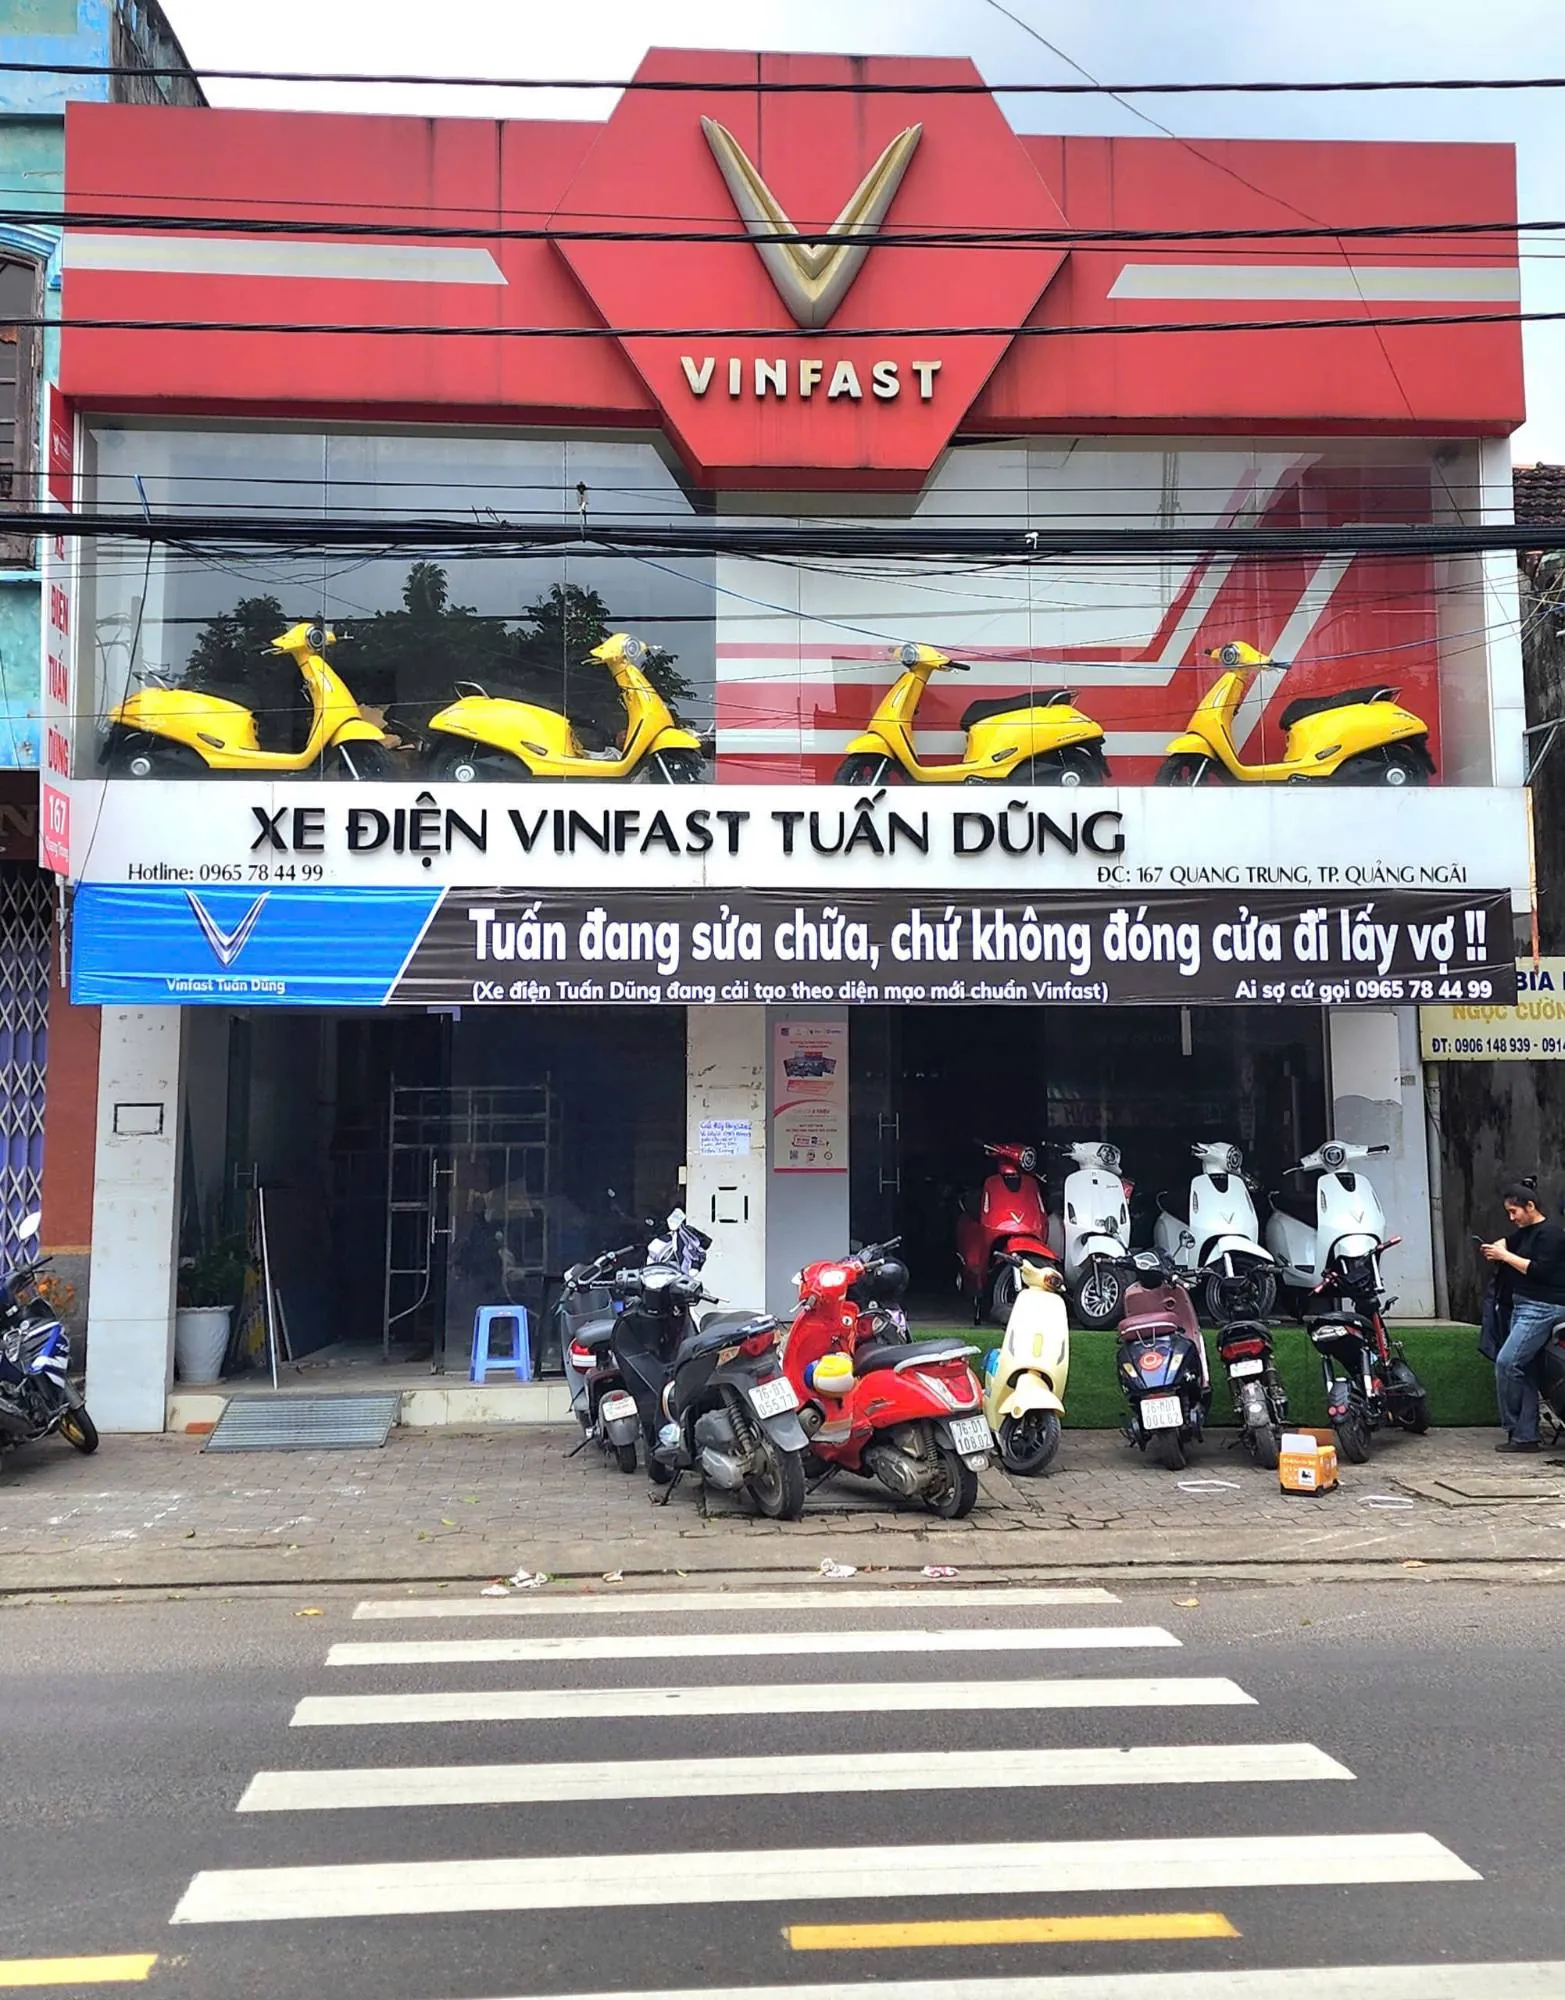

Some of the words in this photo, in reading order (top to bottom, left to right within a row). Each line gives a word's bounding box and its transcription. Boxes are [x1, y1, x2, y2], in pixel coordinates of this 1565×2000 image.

[680, 356, 943, 399] VINFAST
[48, 795, 66, 835] 167
[251, 807, 326, 852] XE
[346, 791, 487, 868] ĐIỆN
[508, 809, 751, 855] VINFAST
[771, 788, 929, 855] TUẤN
[953, 799, 1126, 856] DŨNG
[128, 862, 194, 882] Hotline:
[200, 864, 242, 882] 0965
[248, 864, 269, 882] 78
[274, 864, 296, 882] 44
[302, 864, 323, 882] 99
[1097, 865, 1131, 883] ĐC:
[1136, 866, 1163, 883] 167
[1169, 865, 1240, 886] QUANG
[1246, 866, 1312, 887] TRUNG,
[1317, 866, 1340, 883] TP.
[1345, 859, 1415, 886] QUẢNG
[1420, 862, 1467, 883] NGÃI
[468, 901, 567, 961] Tuấn
[578, 907, 680, 975] đang
[692, 905, 762, 962] sửa
[774, 906, 880, 971] chữa,
[891, 905, 962, 962] chứ
[972, 905, 1091, 976] không
[1104, 905, 1201, 976] đóng
[1212, 905, 1282, 962] cửa
[1293, 907, 1329, 962] đi
[1340, 903, 1399, 976] lấy
[1408, 914, 1456, 975] vợ
[1464, 910, 1488, 962] !!
[166, 977, 213, 993] Vinfast
[472, 981, 504, 1002] (Xe
[509, 980, 550, 1003] điện
[556, 978, 603, 999] Tuấn
[609, 979, 661, 1003] Dũng
[666, 981, 716, 1003] đang
[721, 978, 749, 999] cải
[753, 983, 787, 1003] tạo
[791, 981, 834, 999] theo
[838, 981, 877, 1004] diện
[884, 984, 926, 1003] mạo
[930, 980, 965, 999] mới
[970, 979, 1027, 999] chuẩn
[1032, 981, 1109, 1003] Vinfast)
[1235, 981, 1257, 999] Ai
[1262, 982, 1286, 1003] sợ
[1290, 980, 1315, 999] cứ
[1319, 980, 1351, 1003] gọi
[1355, 981, 1404, 999] 0965
[1409, 981, 1434, 999] 78
[1438, 981, 1463, 999] 44
[1467, 981, 1493, 999] 99
[1515, 971, 1555, 991] BIA
[1453, 1005, 1507, 1024] NGỌC
[1432, 1038, 1452, 1053] ĐT:
[1455, 1037, 1483, 1053] 0906
[1487, 1037, 1507, 1053] 148
[1509, 1037, 1530, 1053] 939
